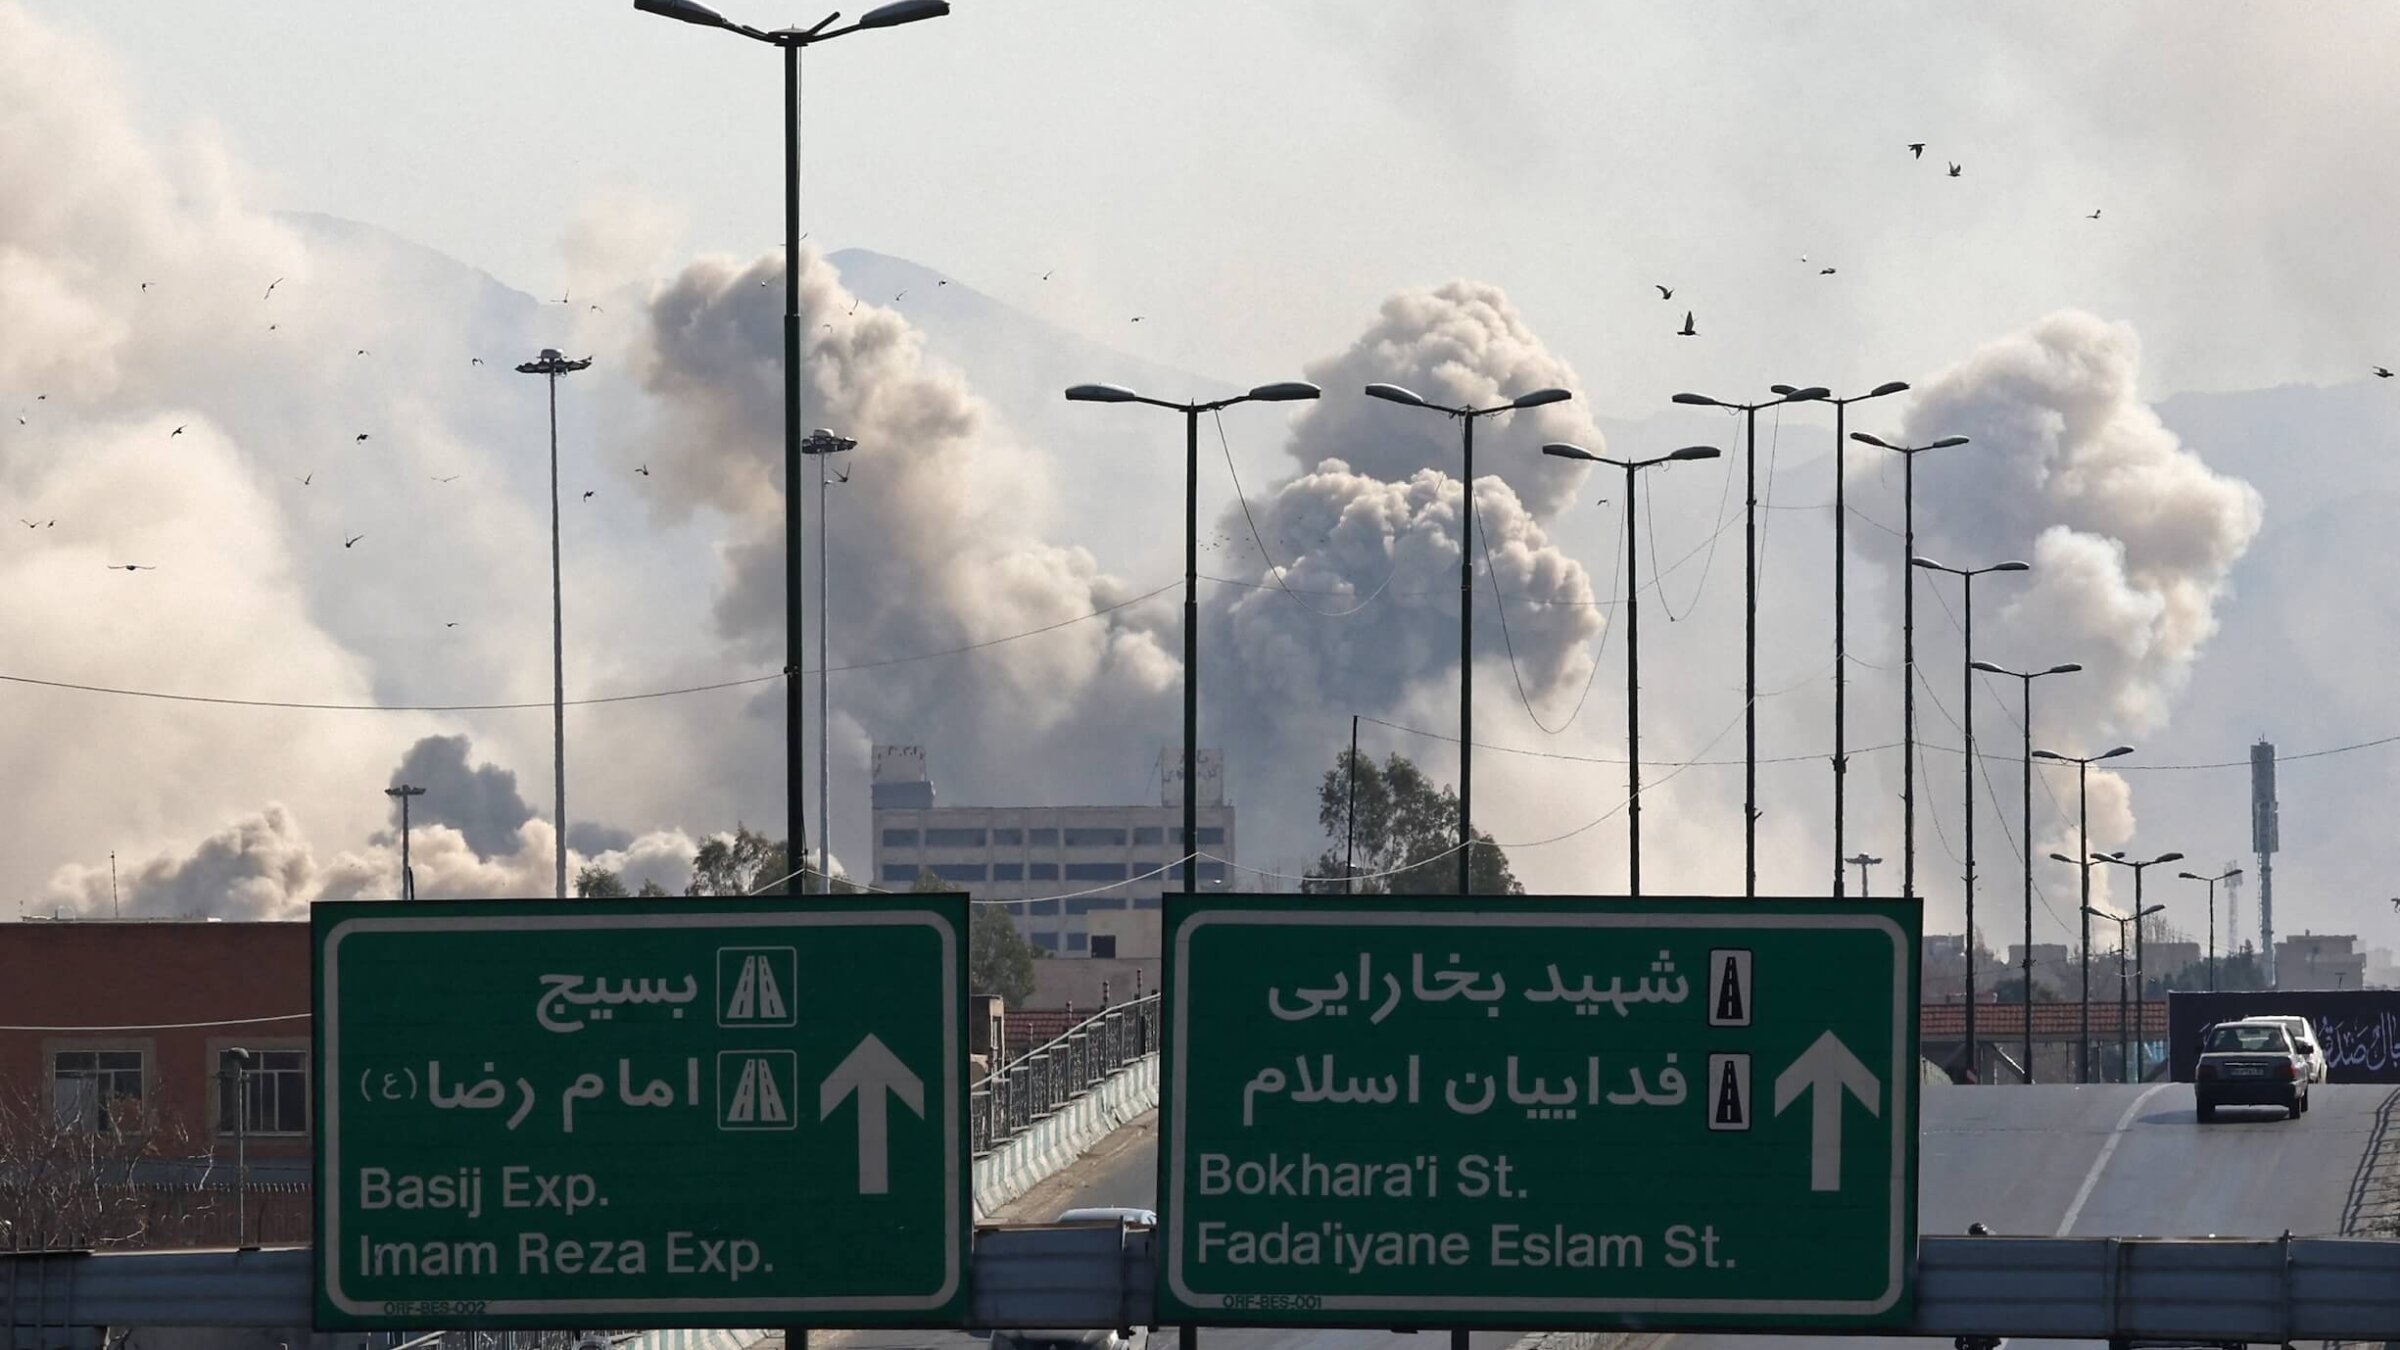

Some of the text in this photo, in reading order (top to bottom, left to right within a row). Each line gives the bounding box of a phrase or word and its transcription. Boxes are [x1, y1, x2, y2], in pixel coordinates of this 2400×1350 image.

[536, 973, 698, 1032] بسیج
[1268, 949, 1690, 1024] شهید بخارایی
[562, 1058, 699, 1132] امام
[1242, 1052, 1688, 1127] فداییان اسلام
[360, 1166, 609, 1218] Basij Exp.
[1199, 1153, 1528, 1199] Bokhara'i St.
[361, 1231, 773, 1282] Imam Reza Exp.
[1198, 1221, 1736, 1274] Fada'iyane Eslam St.
